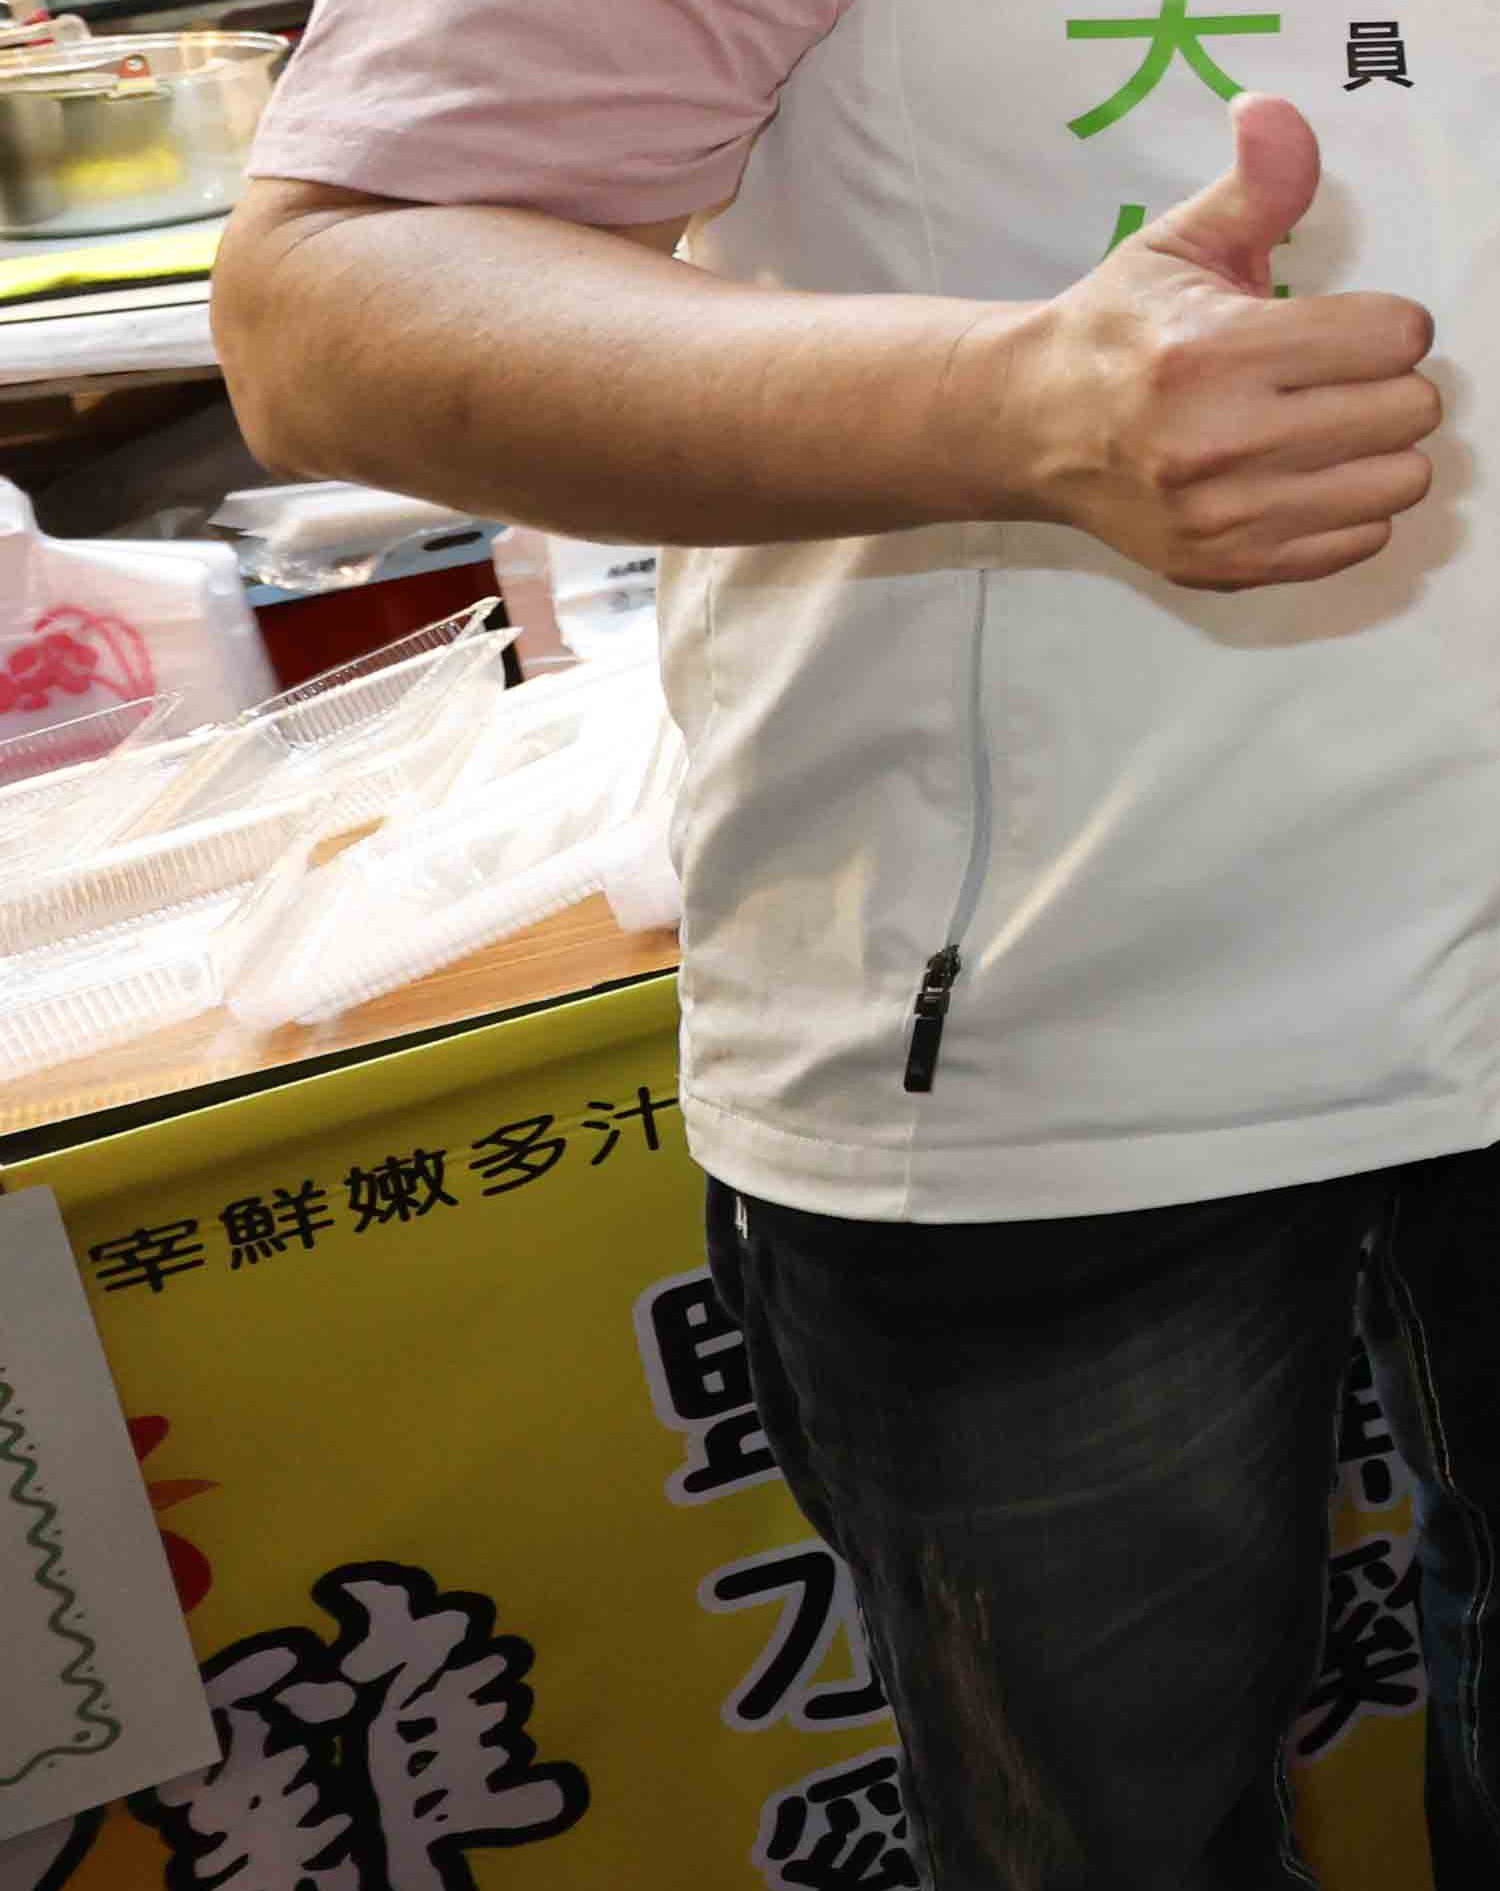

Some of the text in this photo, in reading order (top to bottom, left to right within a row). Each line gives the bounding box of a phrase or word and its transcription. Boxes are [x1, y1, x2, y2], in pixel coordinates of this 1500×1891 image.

[88, 1085, 679, 1293] 宰鮮嫩多汁
